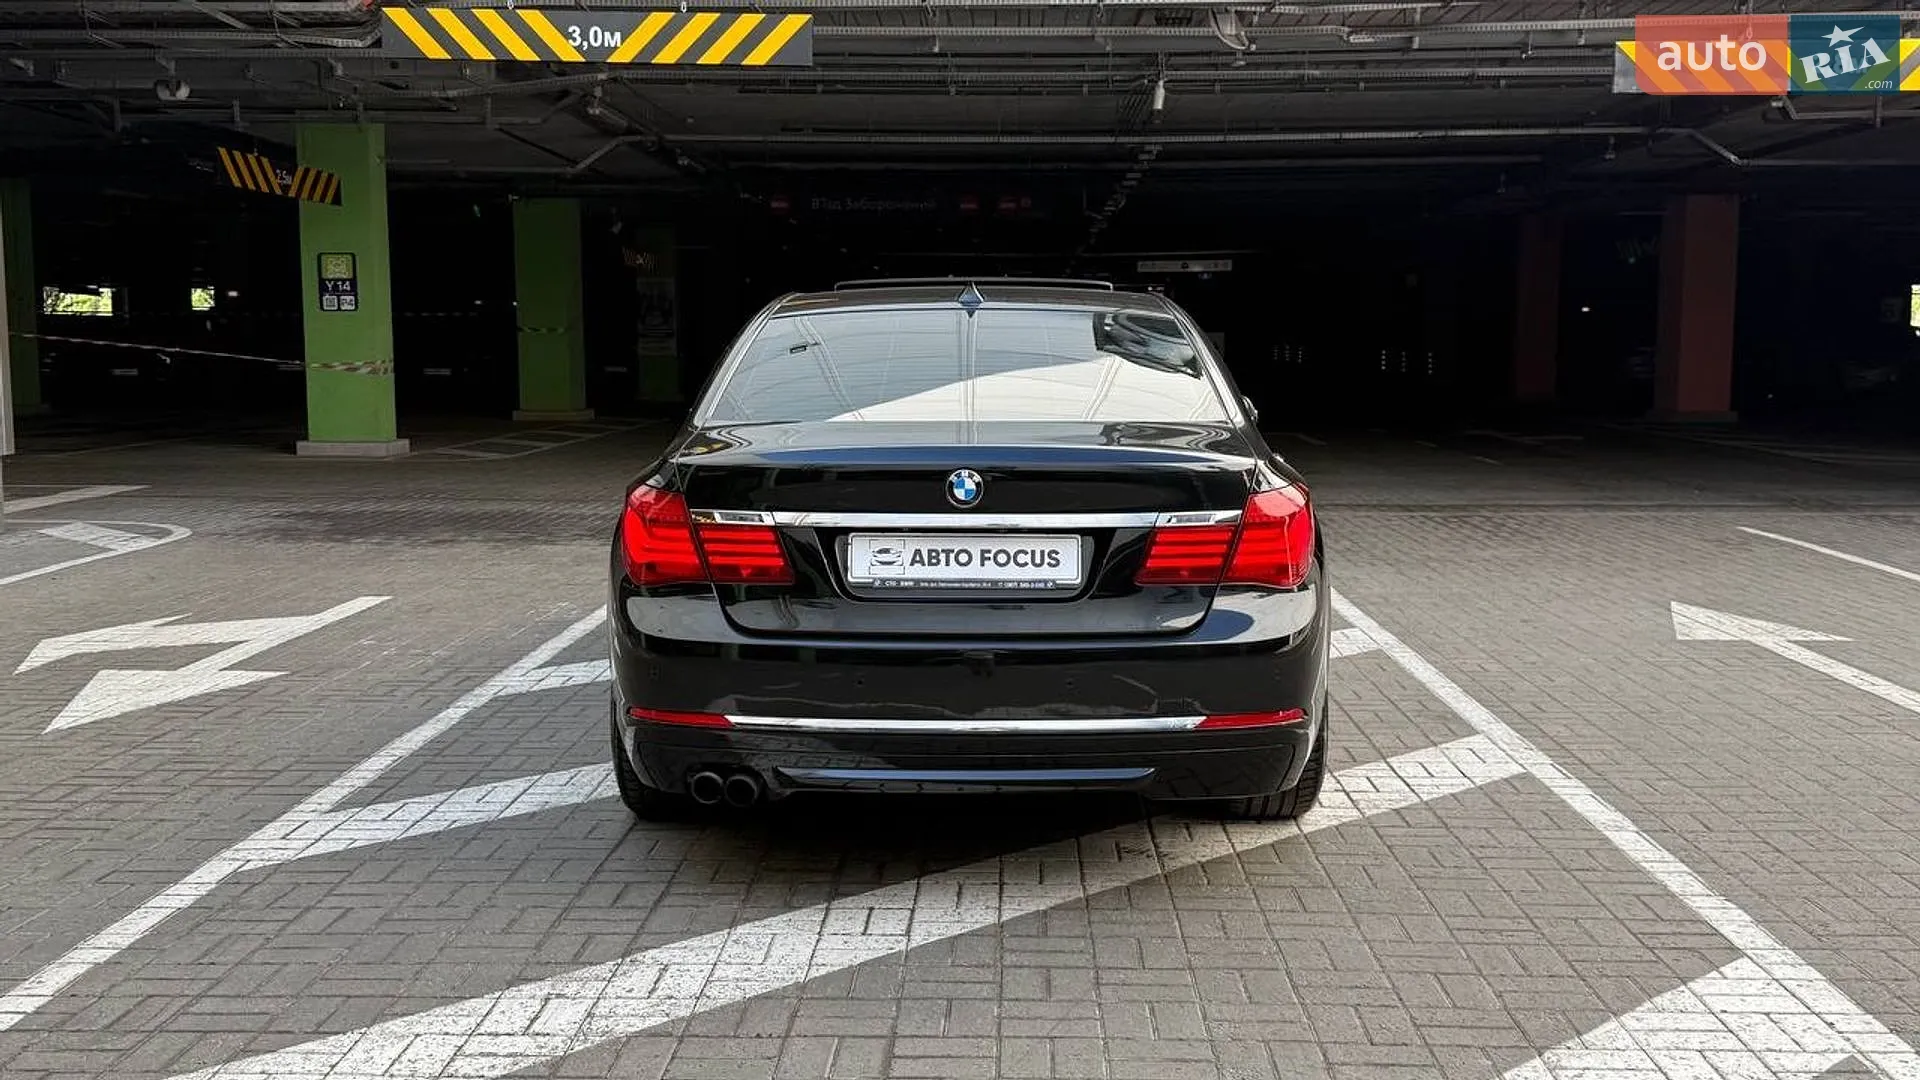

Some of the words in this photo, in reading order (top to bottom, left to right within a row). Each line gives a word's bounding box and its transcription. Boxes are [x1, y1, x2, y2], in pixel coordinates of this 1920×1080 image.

[567, 25, 621, 51] 3,0м
[325, 280, 335, 291] Y
[336, 280, 351, 291] 14
[979, 548, 1061, 568] FOCUS
